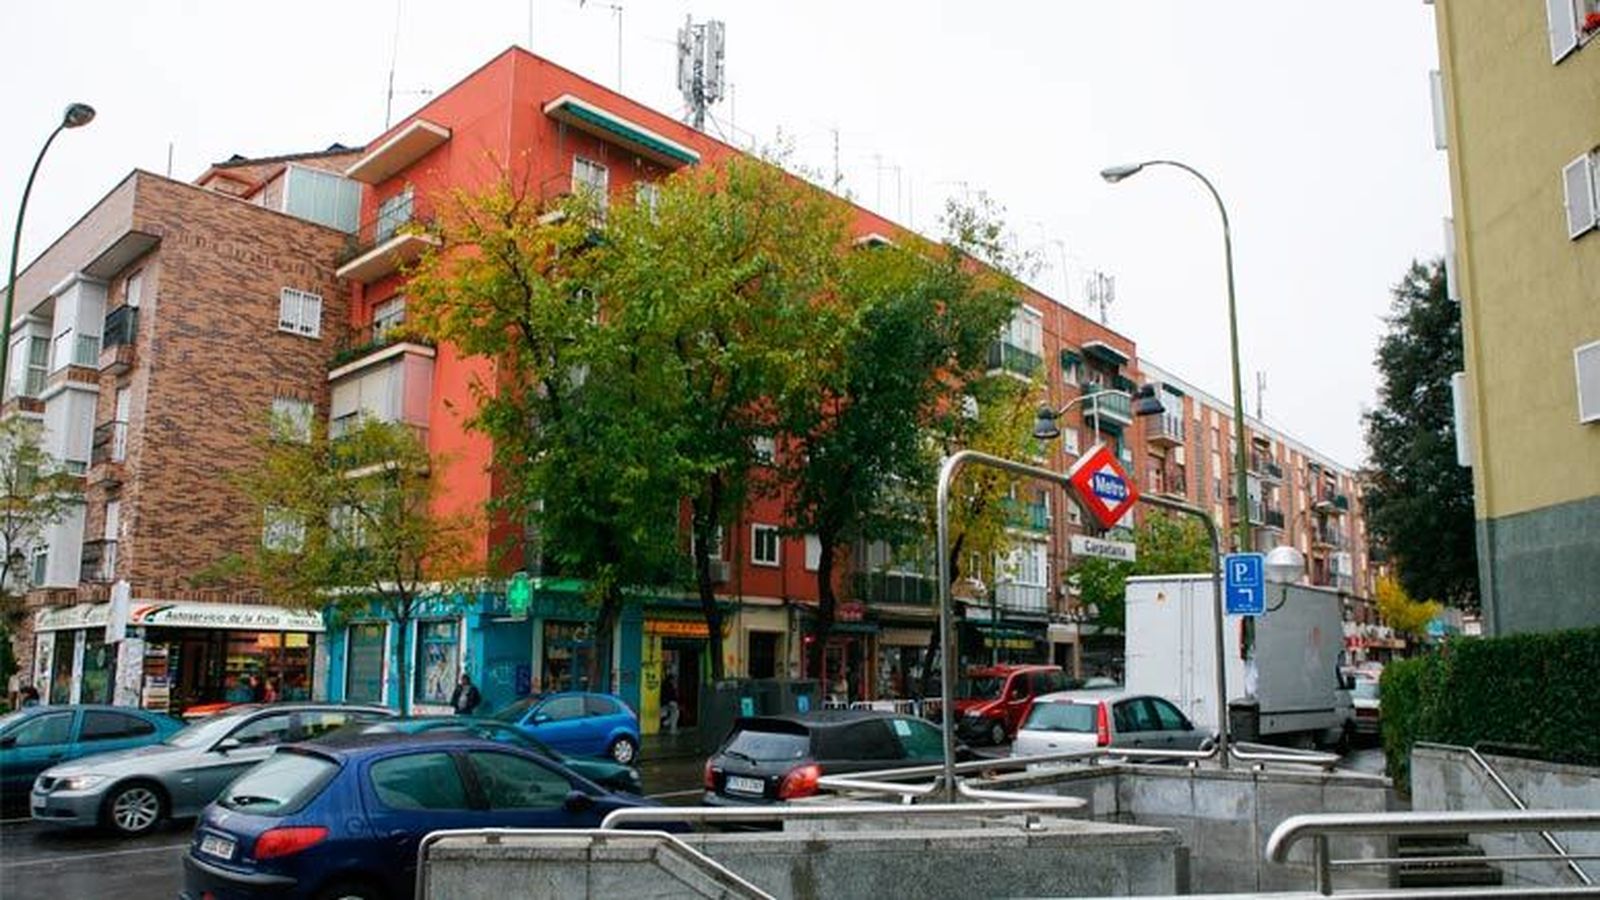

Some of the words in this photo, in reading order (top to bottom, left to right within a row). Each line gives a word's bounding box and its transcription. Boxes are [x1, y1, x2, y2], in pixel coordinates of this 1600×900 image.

[1096, 475, 1125, 499] Metro
[1084, 540, 1126, 557] Carpetana
[1235, 563, 1248, 582] P
[229, 612, 240, 622] de
